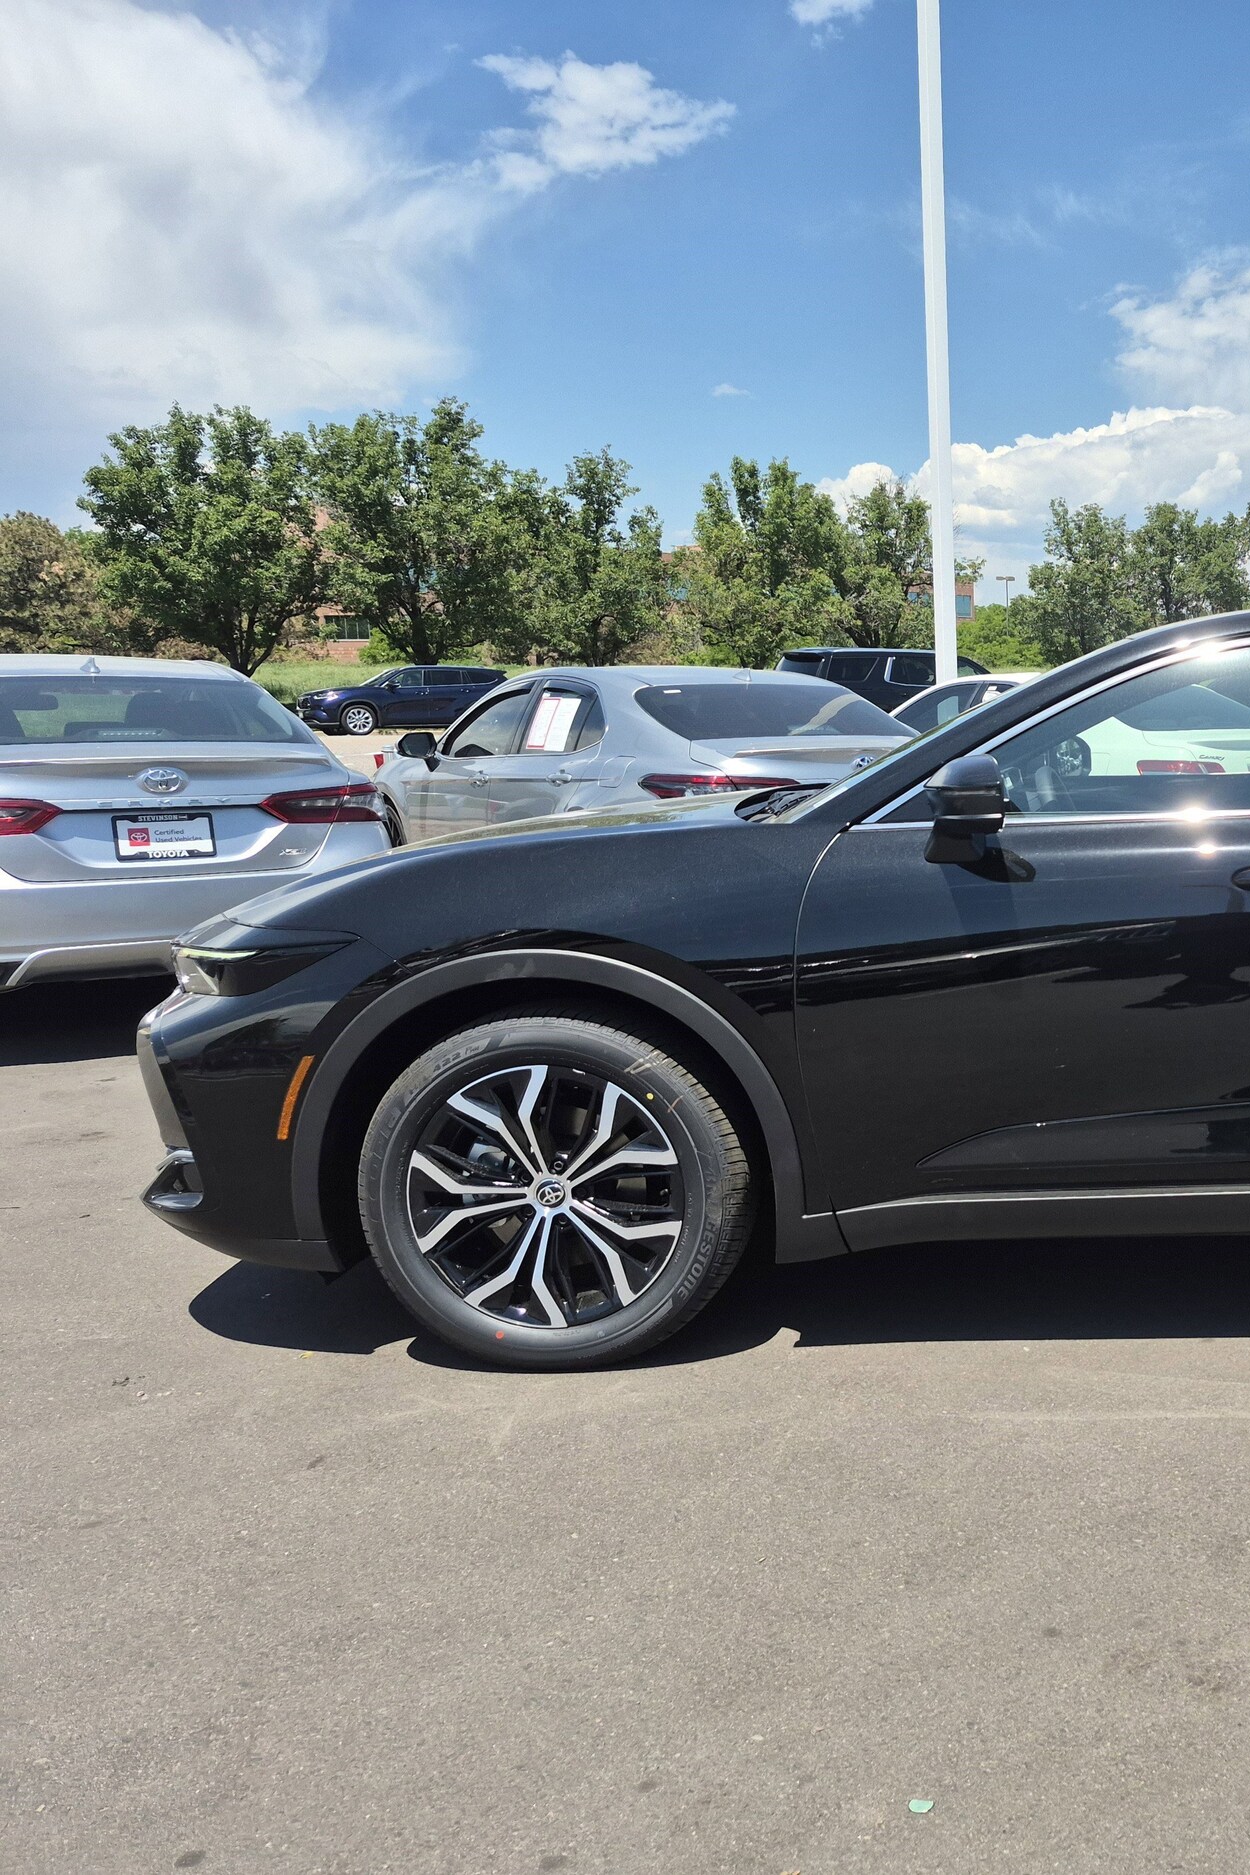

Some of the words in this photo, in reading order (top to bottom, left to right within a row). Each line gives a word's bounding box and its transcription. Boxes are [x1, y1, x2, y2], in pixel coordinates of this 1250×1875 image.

[138, 814, 178, 822] STEVINSON
[174, 835, 202, 843] Vehicles
[147, 849, 189, 859] TOYOTA
